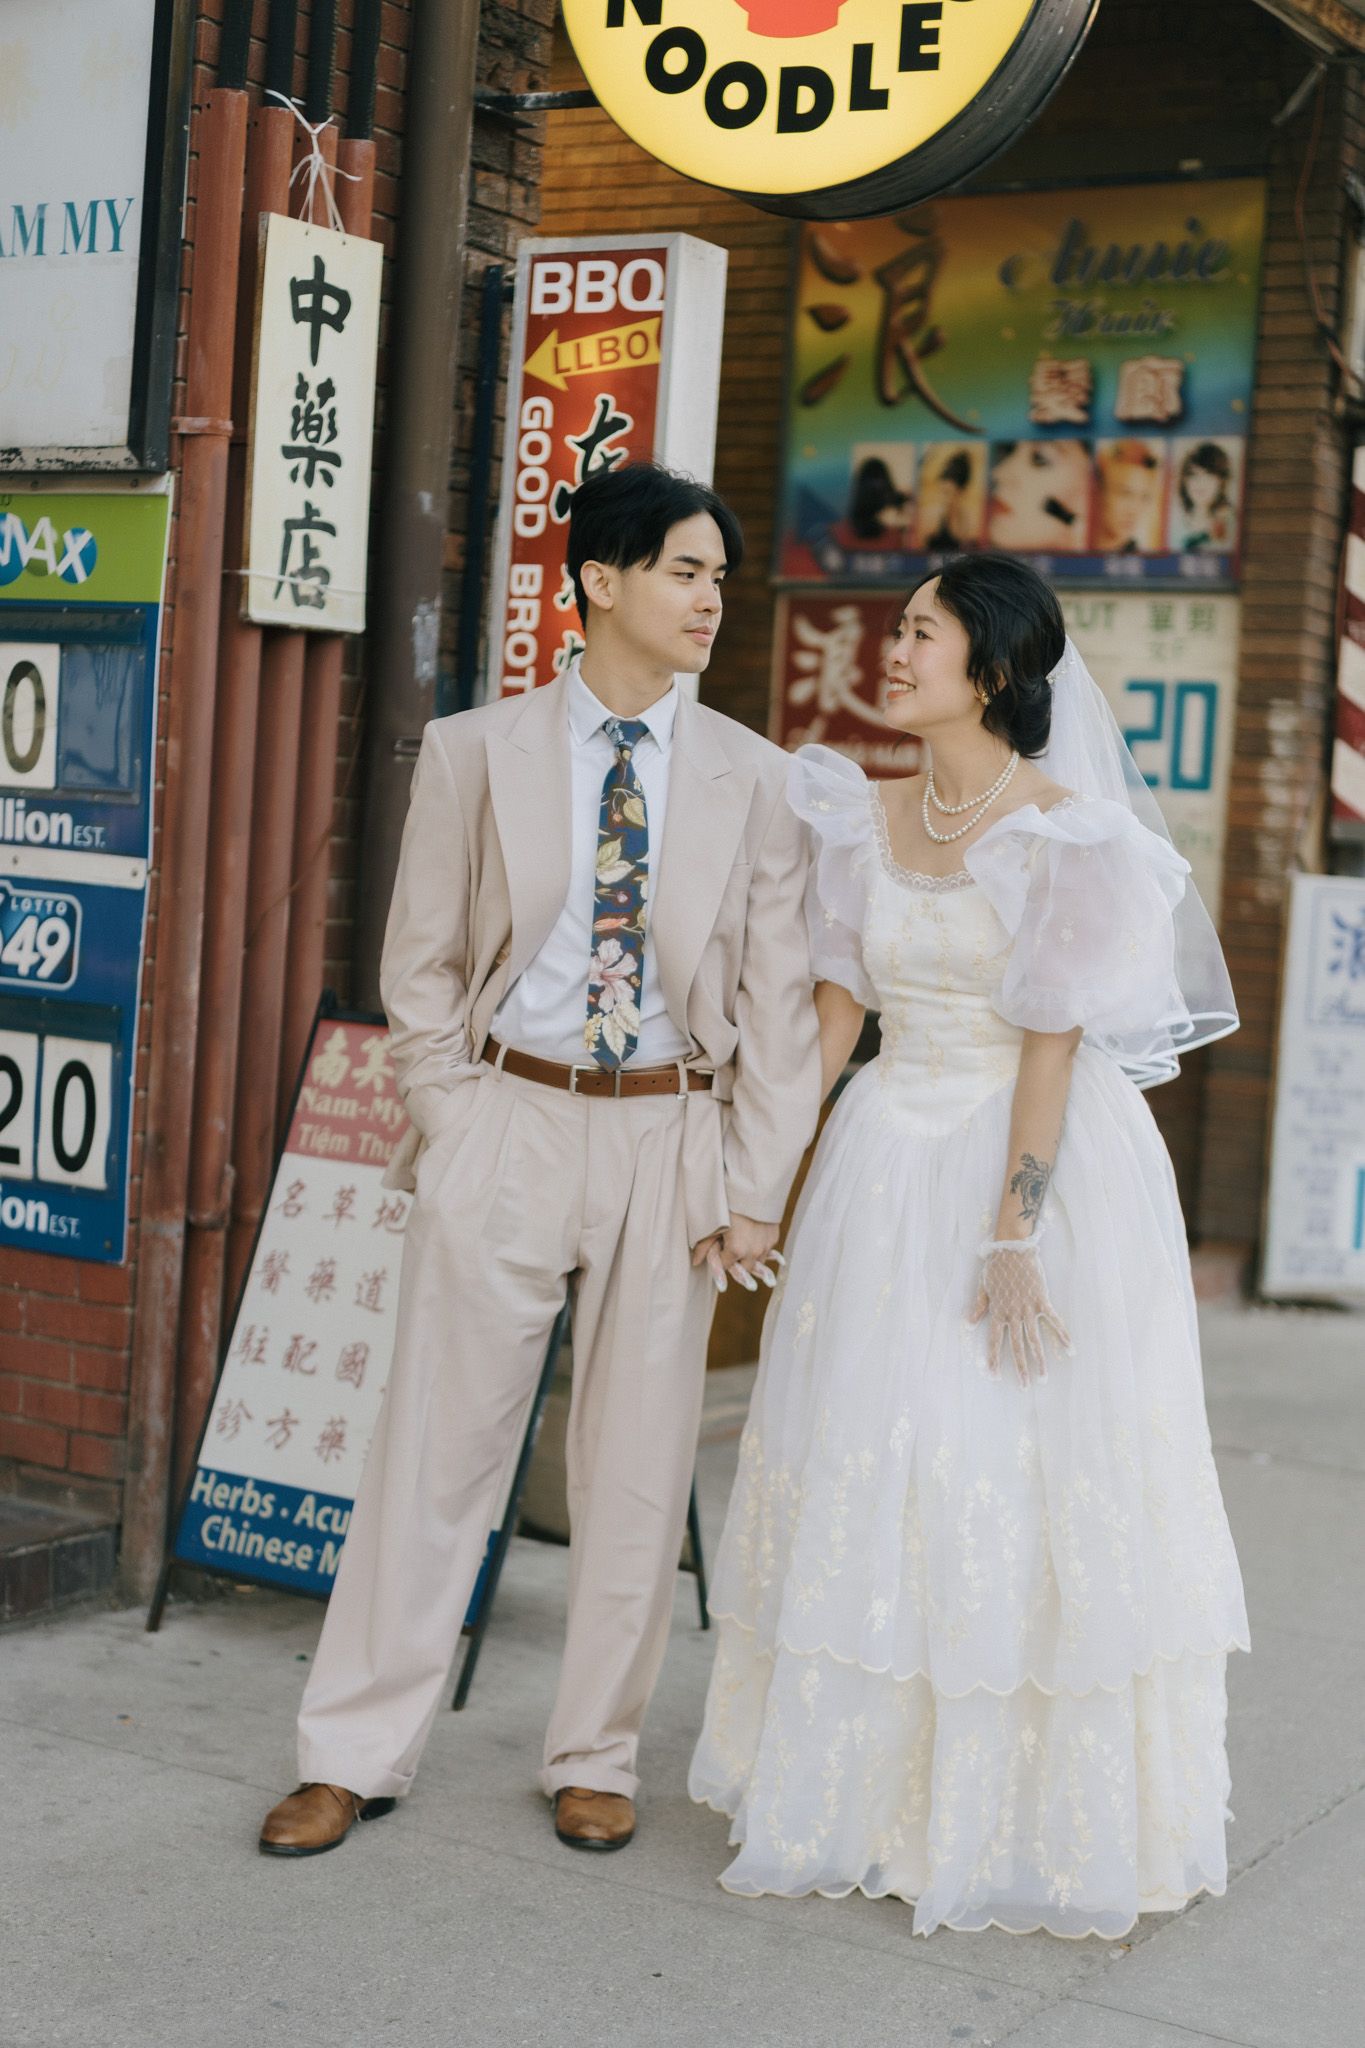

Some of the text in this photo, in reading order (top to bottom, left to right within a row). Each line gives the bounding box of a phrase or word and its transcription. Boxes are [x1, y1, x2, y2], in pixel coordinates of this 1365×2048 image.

[606, 0, 975, 134] OODLE
[530, 258, 665, 315] BBQ
[273, 254, 351, 610] 中藥店
[514, 396, 554, 538] GOOD
[3, 660, 46, 773] 0
[10, 895, 67, 916] LOTTO
[0, 915, 71, 979] 49
[190, 1470, 350, 1536] Herbs Acu
[200, 1515, 313, 1570] Chinese
